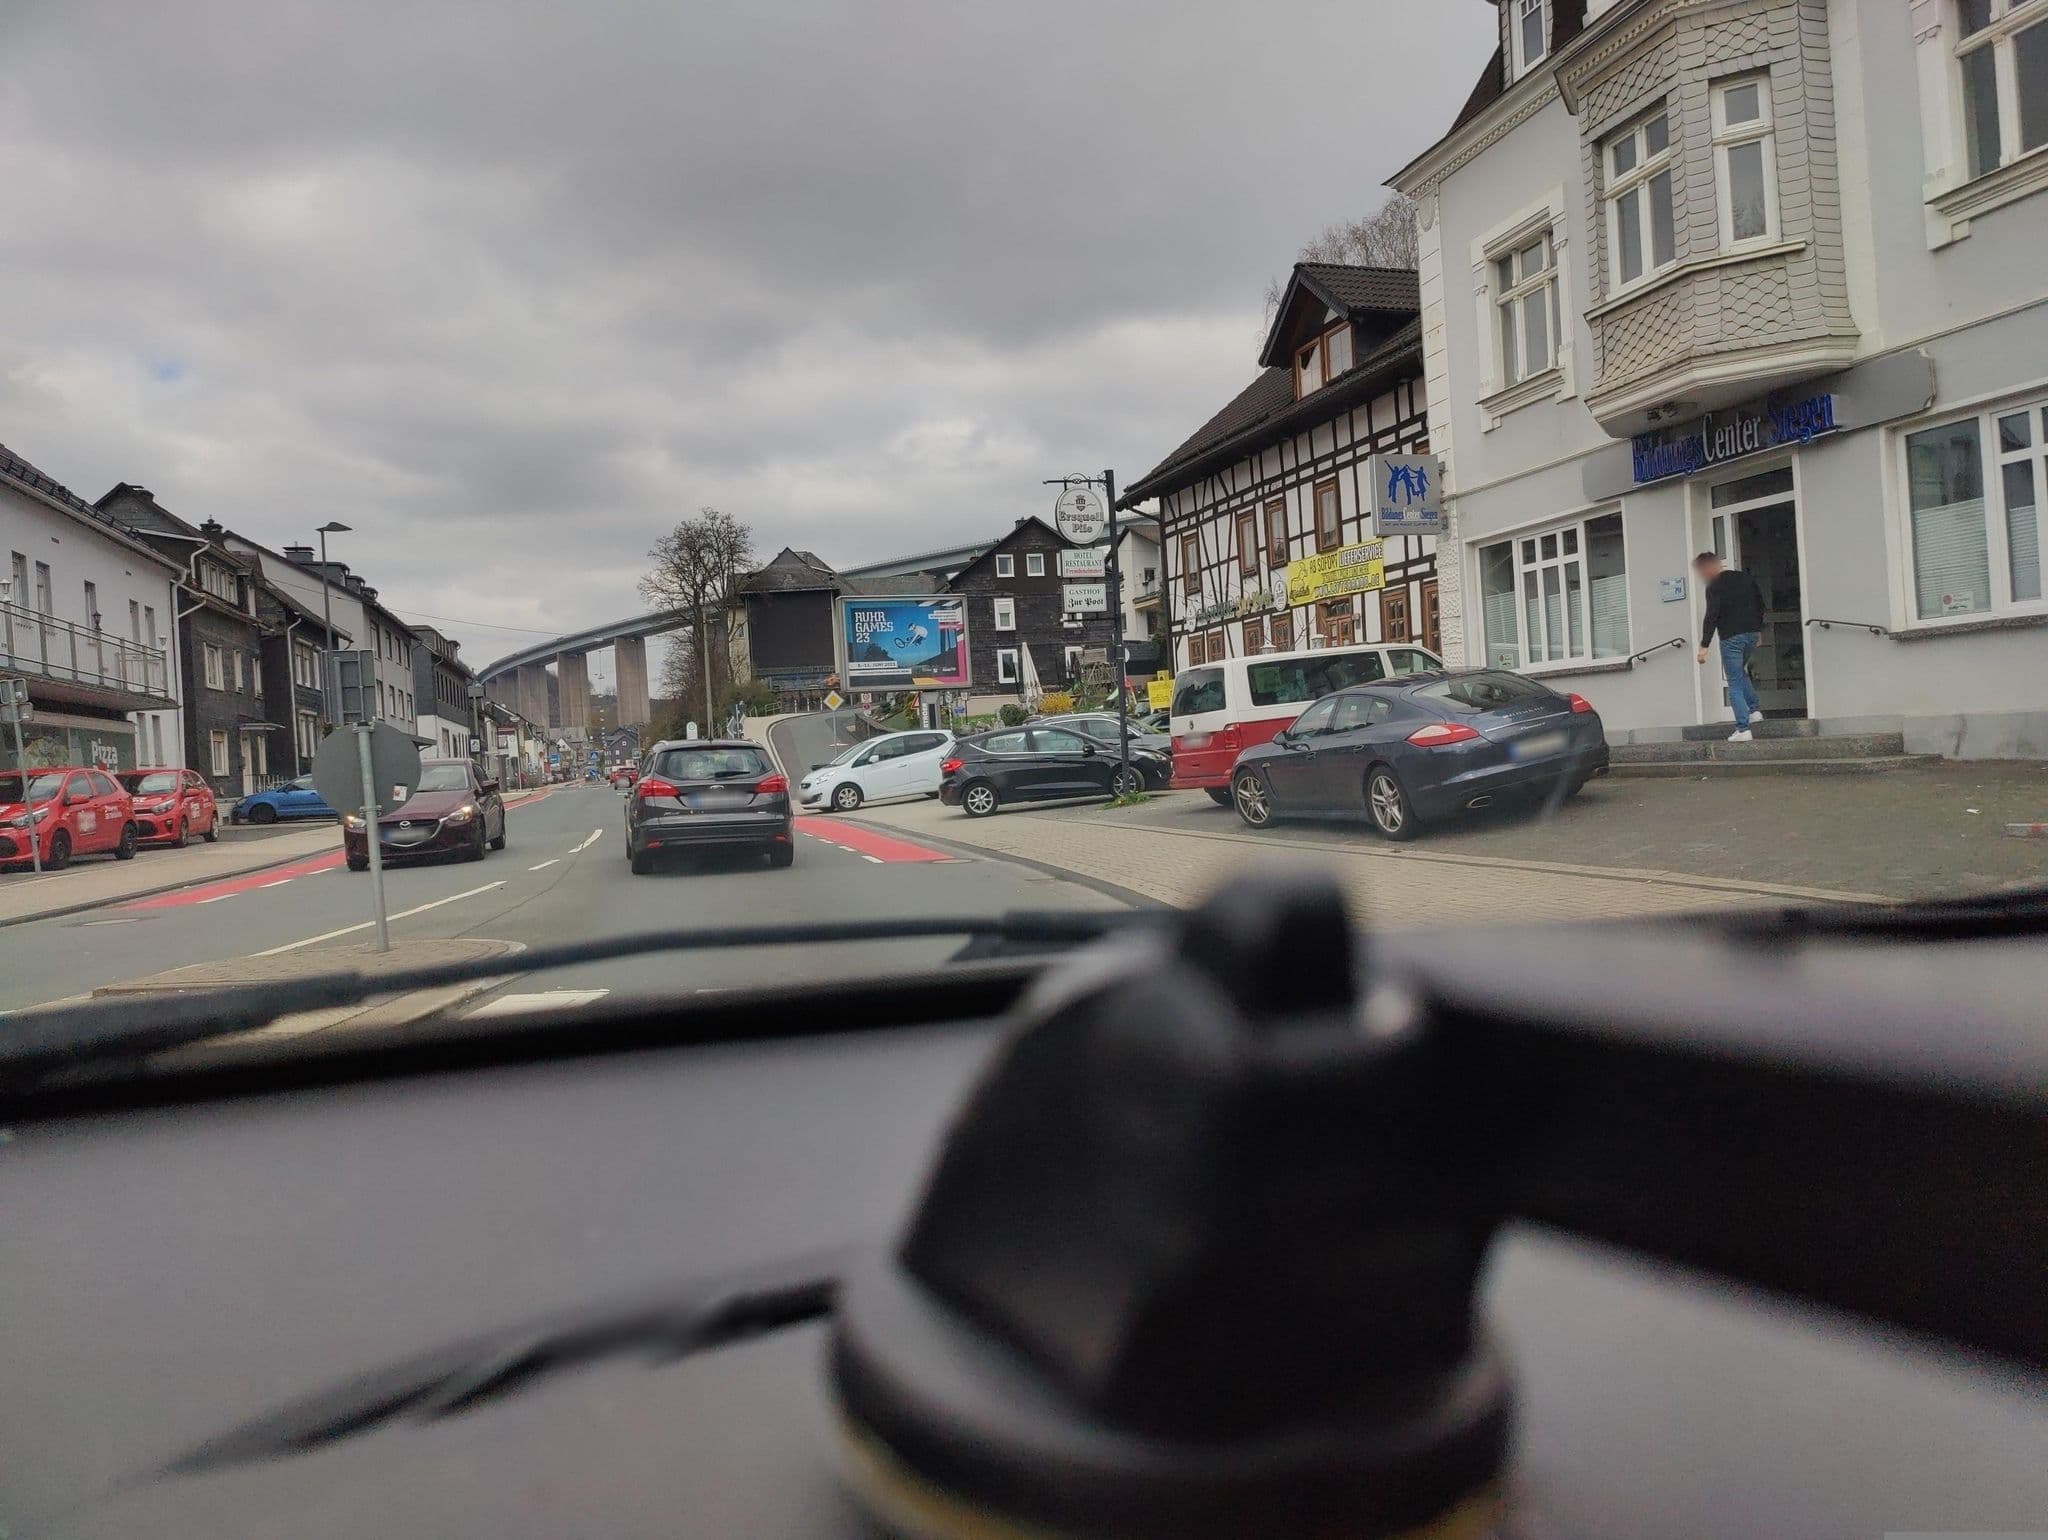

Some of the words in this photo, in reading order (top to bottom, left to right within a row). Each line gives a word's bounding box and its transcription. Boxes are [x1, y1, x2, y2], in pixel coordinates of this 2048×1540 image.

[1702, 413, 1761, 462] Center
[1766, 391, 1834, 444] Siegen
[1065, 559, 1102, 567] RESTAURANT
[1317, 553, 1338, 572] SOFORT
[854, 611, 885, 622] RUHR
[855, 621, 894, 632] GAMES
[856, 633, 870, 643] 23
[91, 738, 118, 764] Pizza
